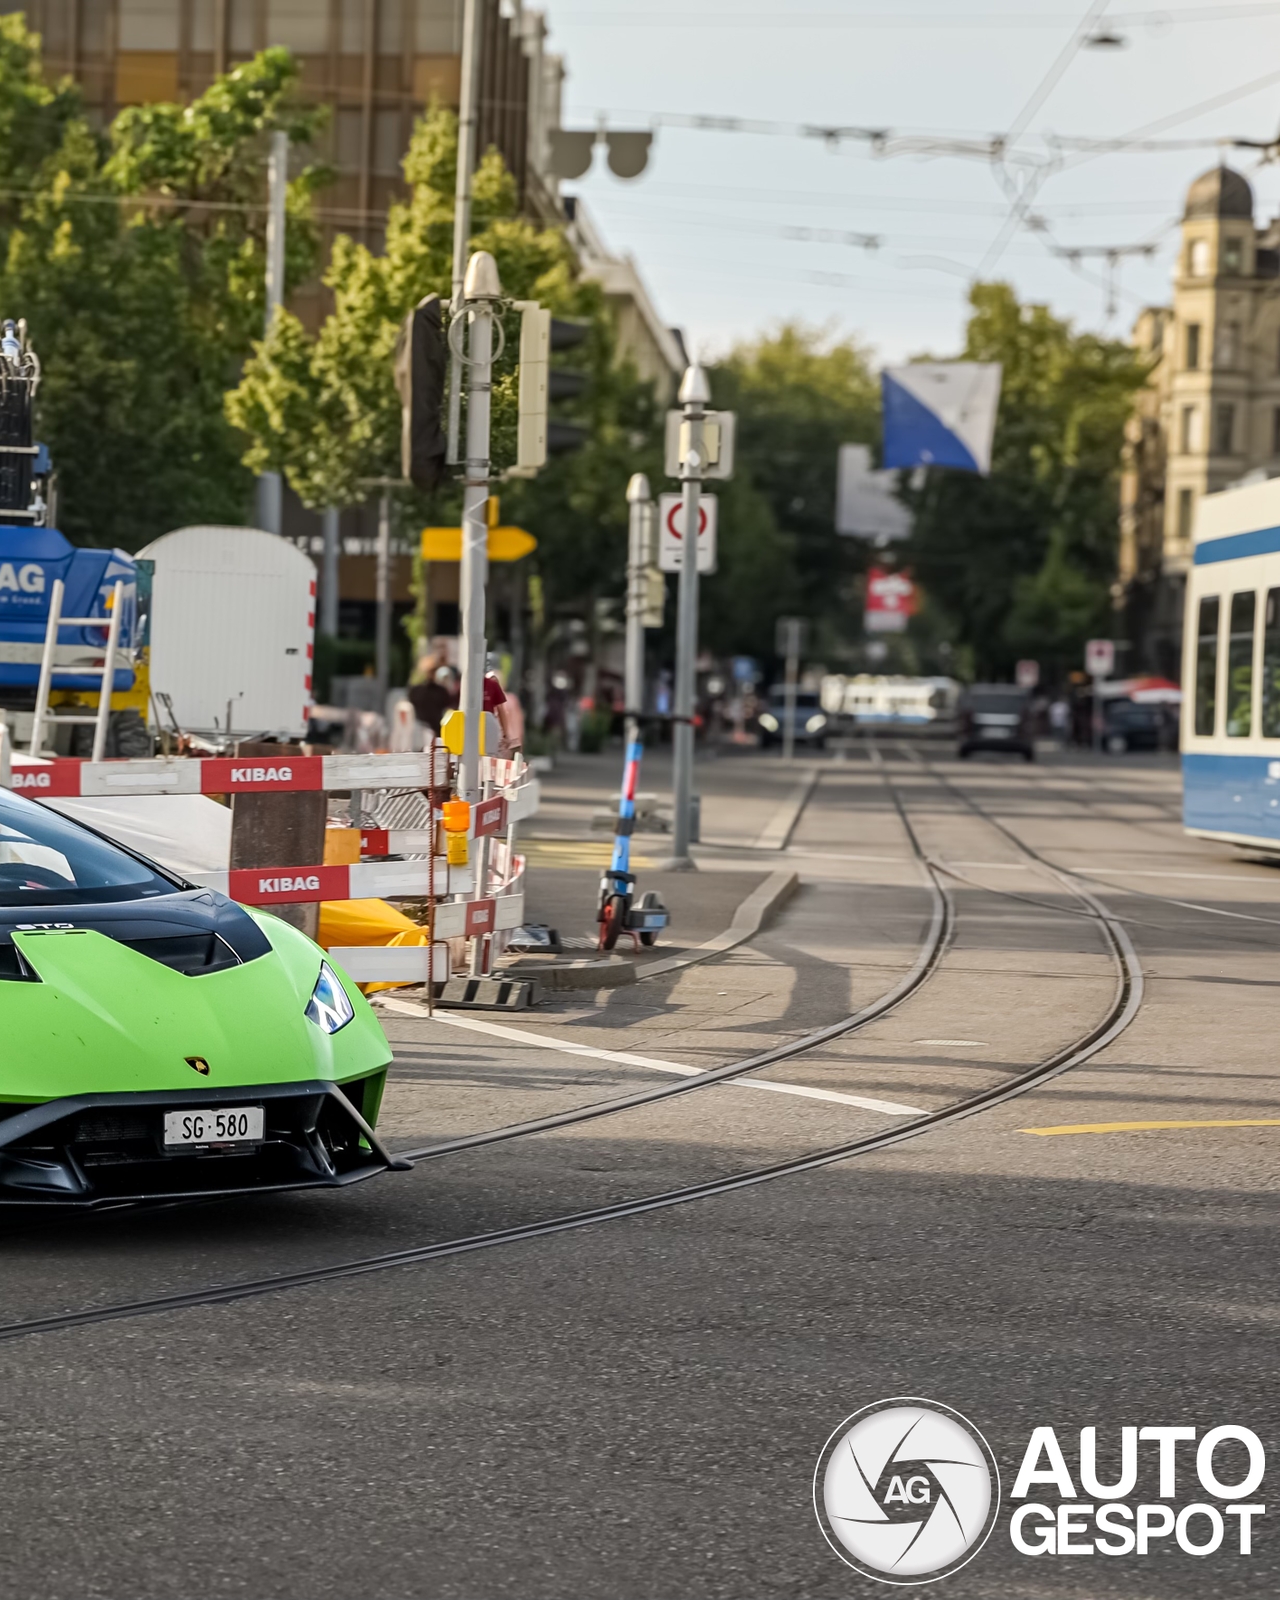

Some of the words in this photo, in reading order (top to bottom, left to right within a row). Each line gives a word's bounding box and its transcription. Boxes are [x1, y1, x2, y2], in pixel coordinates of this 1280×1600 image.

[11, 772, 51, 788] BAG
[230, 767, 293, 783] KIBAG
[258, 875, 320, 894] KIBAG
[16, 922, 75, 930] STO
